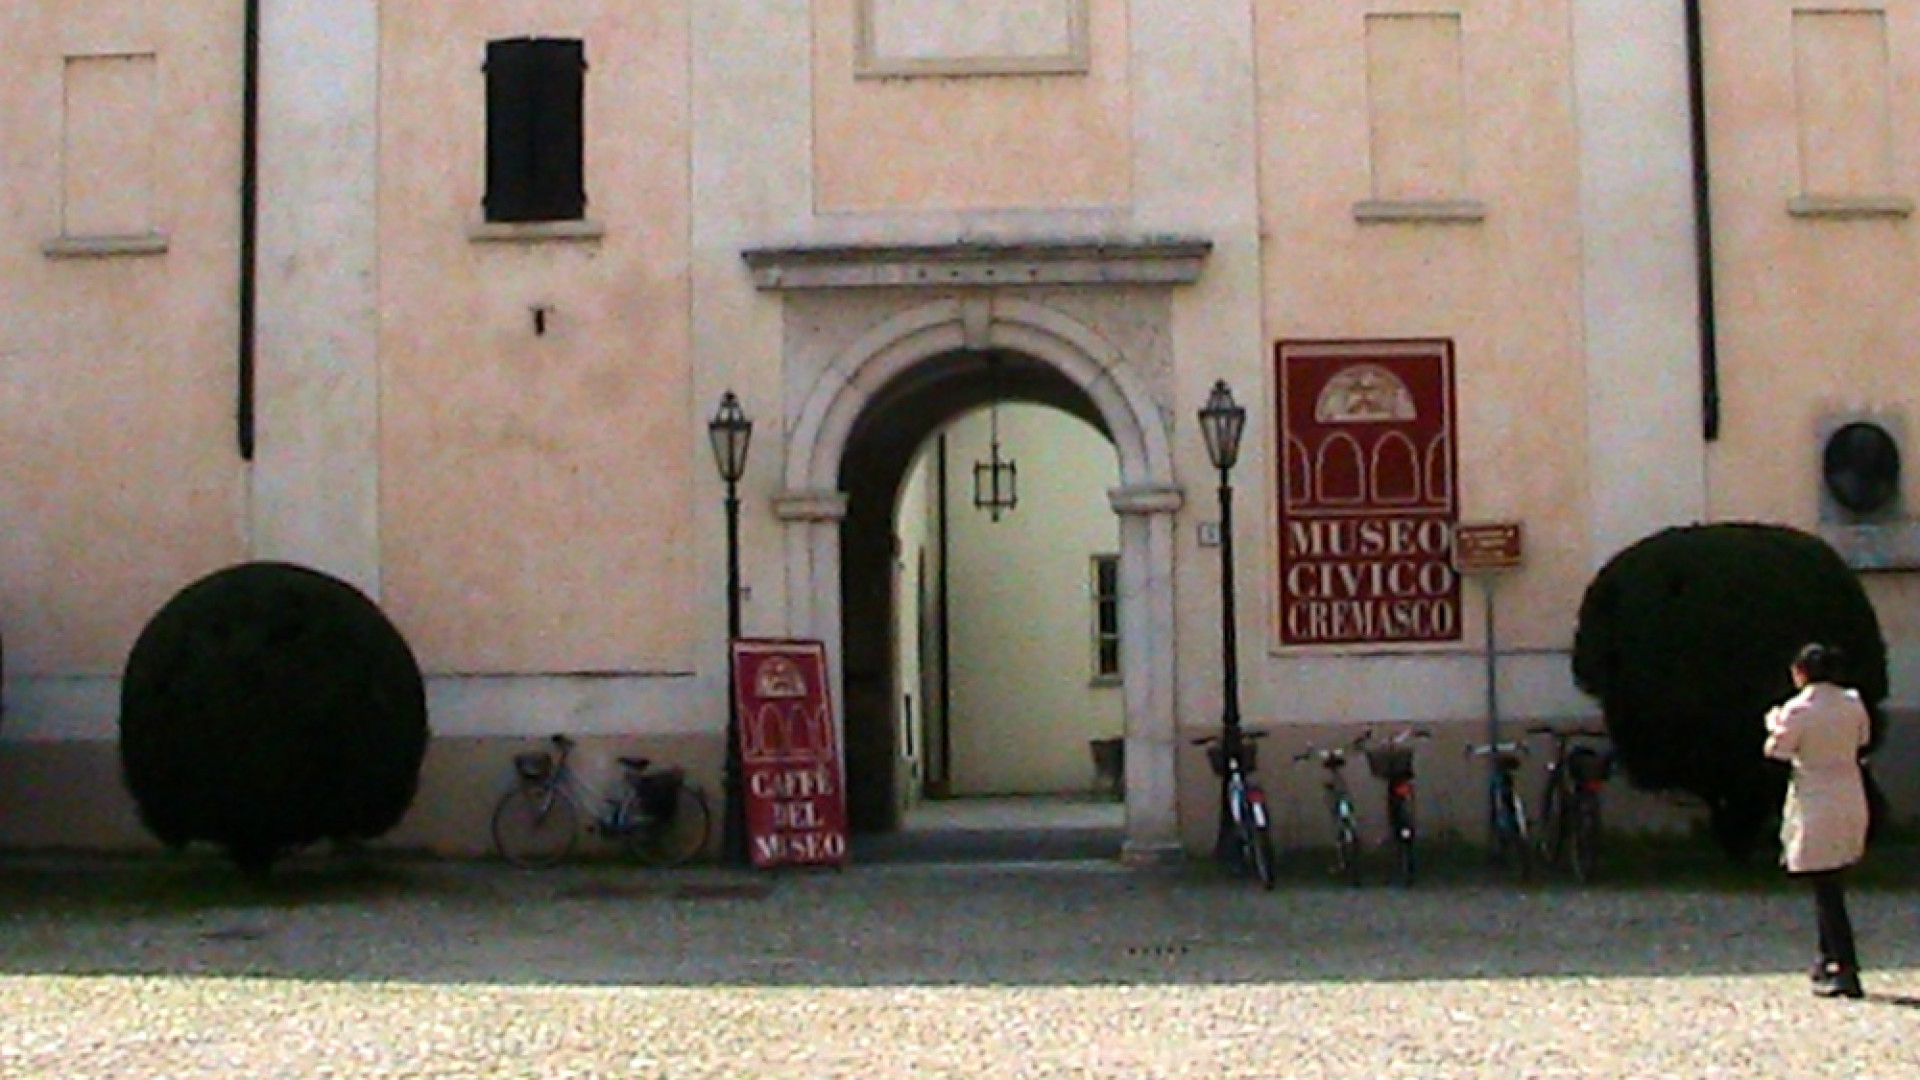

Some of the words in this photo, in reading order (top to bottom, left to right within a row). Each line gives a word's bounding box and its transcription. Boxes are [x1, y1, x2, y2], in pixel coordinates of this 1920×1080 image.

[1289, 519, 1450, 556] MUSEO
[1287, 562, 1452, 597] CIVICO
[1288, 601, 1453, 638] CREMASCO
[772, 801, 824, 828] DEL
[755, 832, 845, 862] MUSEO
